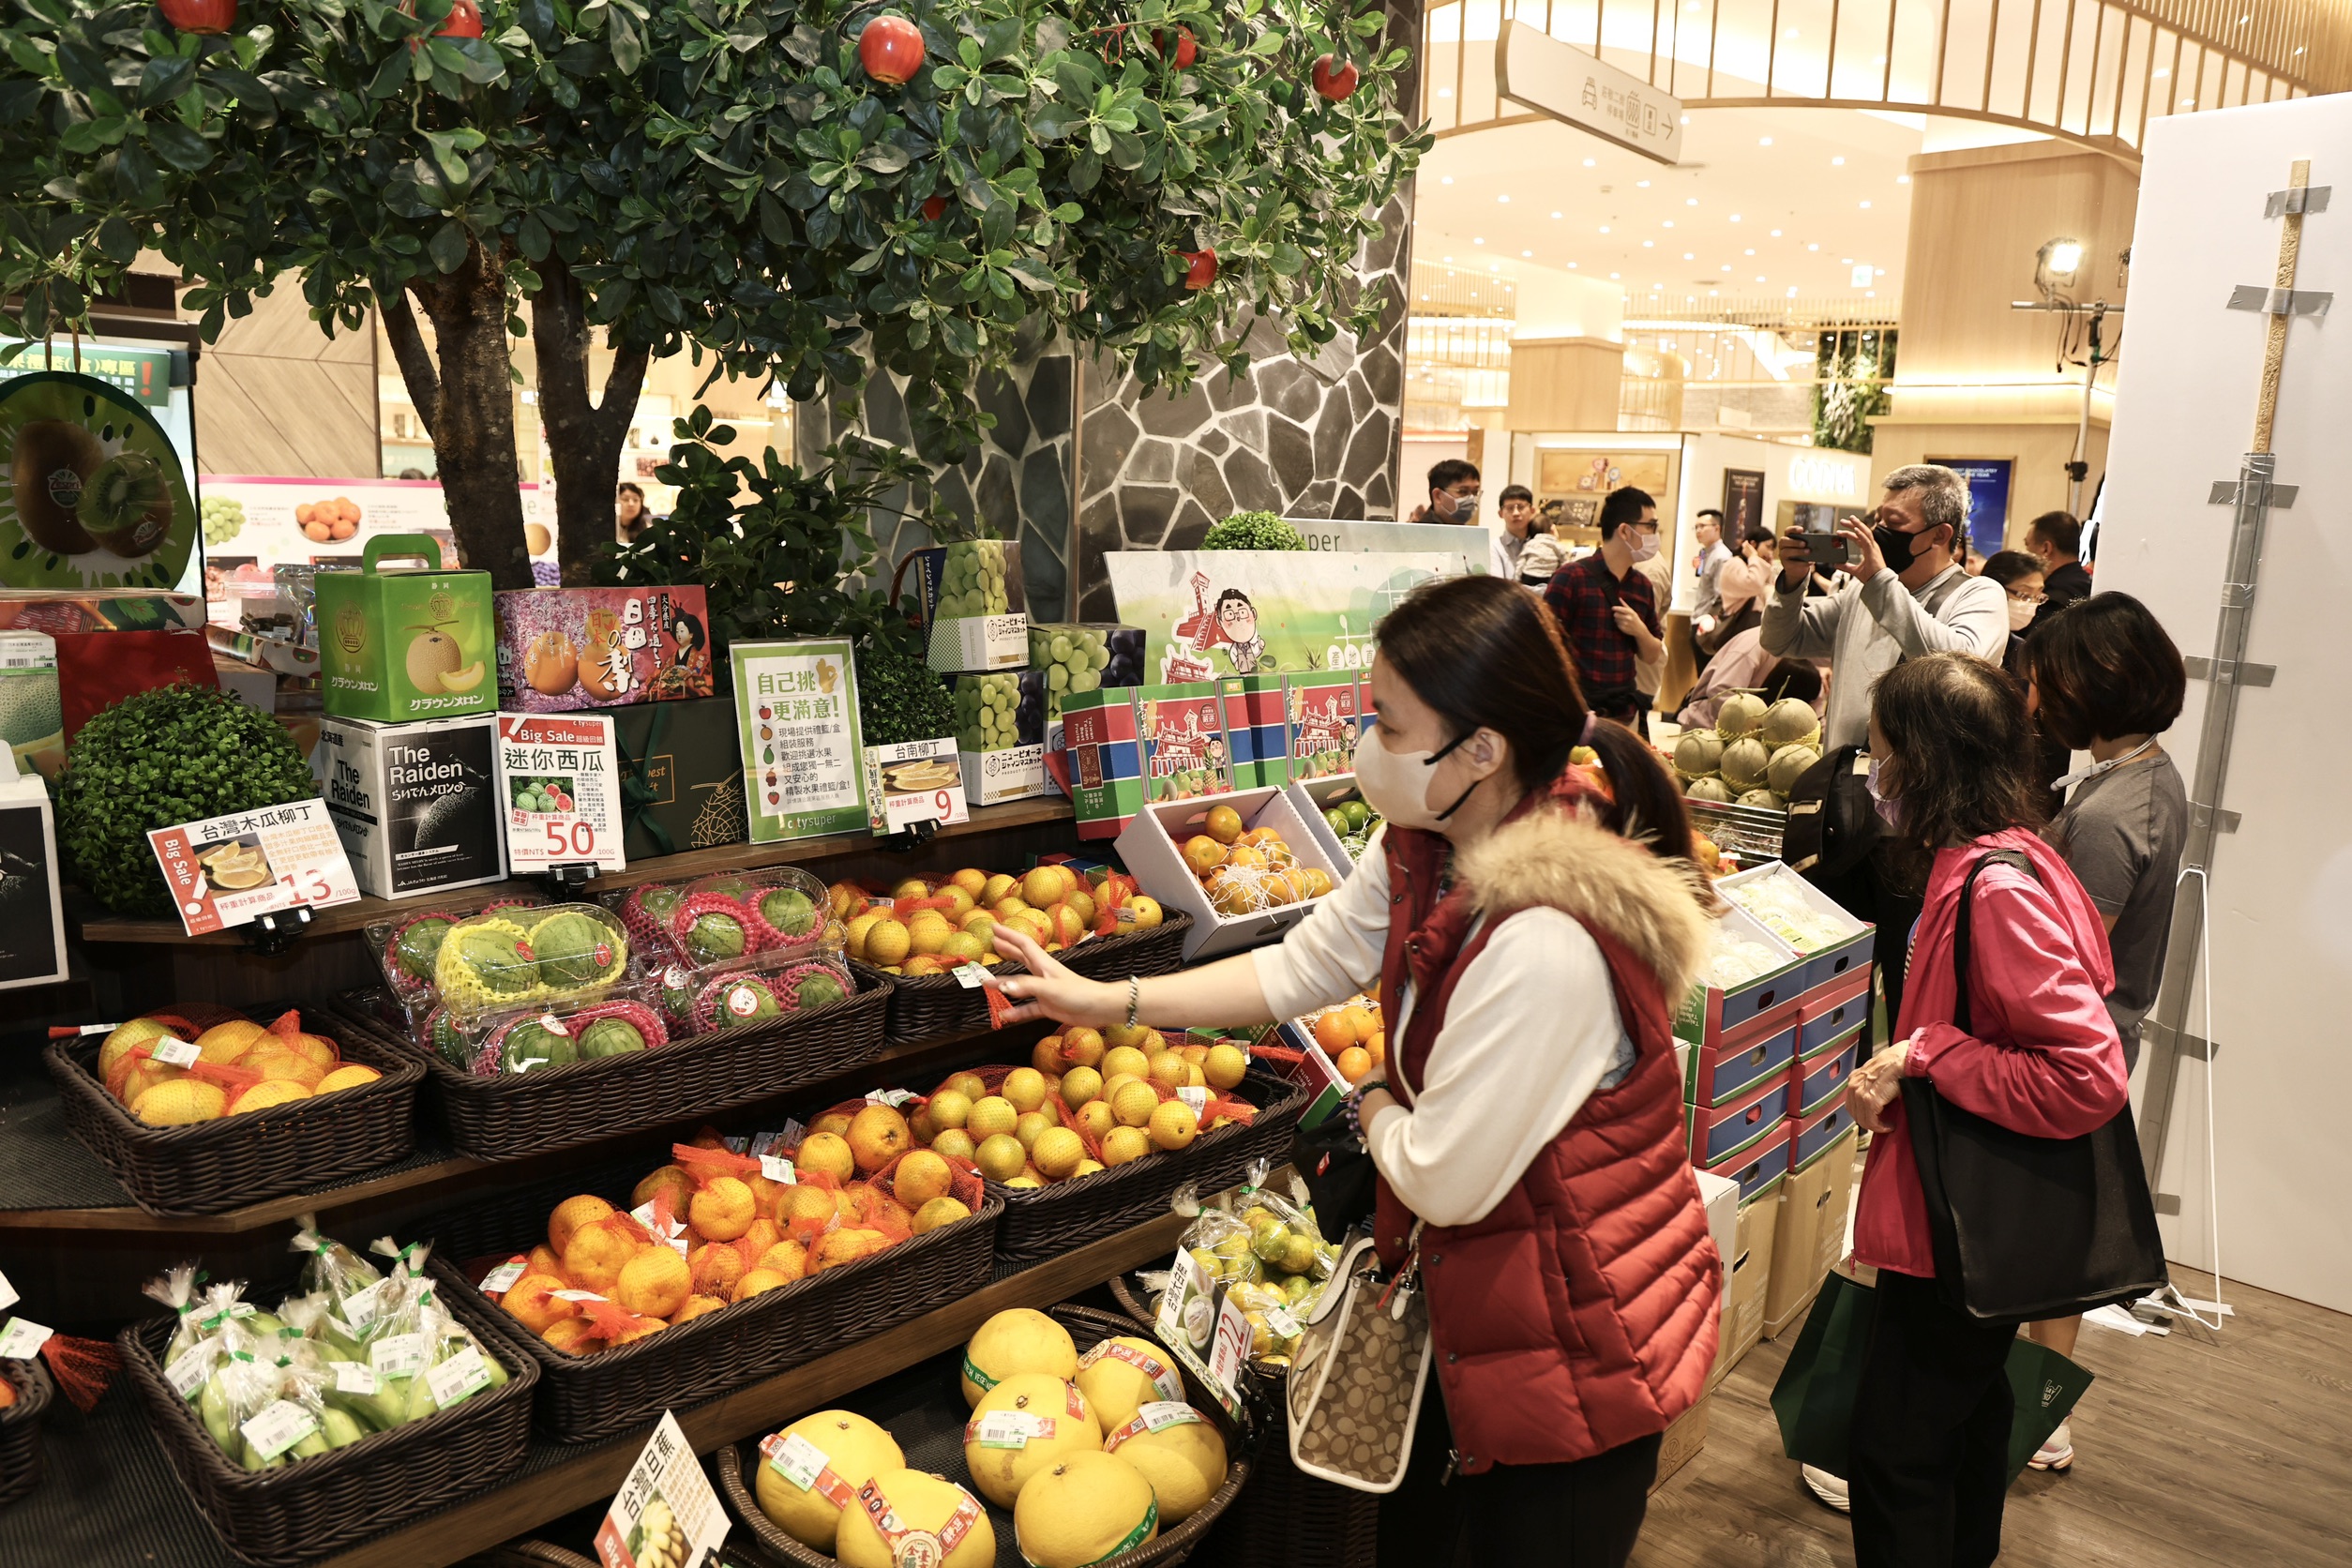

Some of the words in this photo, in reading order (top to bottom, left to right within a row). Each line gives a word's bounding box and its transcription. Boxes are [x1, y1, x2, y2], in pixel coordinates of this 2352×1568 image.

[51, 478, 80, 490] Zespri
[924, 555, 935, 610] シャインマスカット
[660, 596, 671, 629] 大分県産
[997, 617, 1026, 627] ニューピオーネ
[591, 612, 606, 647] 日本
[624, 598, 647, 649] 日田
[998, 626, 1027, 636] シャインマスカット
[331, 676, 379, 692] クラウンメロン
[758, 670, 816, 695] 自己挑
[410, 693, 485, 711] クラウンメロン
[772, 696, 839, 722] 更滿意!
[520, 730, 543, 744] Big
[547, 730, 575, 742] Sale
[778, 723, 841, 737] 現場提供禮籃/盒
[779, 737, 814, 749] 組裝服務
[896, 741, 940, 760] 台南柳丁
[389, 746, 430, 766] The
[505, 747, 605, 772] 迷你西瓜
[781, 747, 833, 761] 歡迎挑選水果
[1002, 747, 1042, 761] ニューピオーネ
[1002, 758, 1042, 769] シャインマスカット
[338, 760, 360, 785] The
[389, 762, 463, 786] Raiden
[782, 759, 842, 773] 組成您獨一無二
[784, 773, 819, 785] 又安心的
[785, 780, 851, 796] 精製水果禮籃/盒!
[331, 779, 370, 810] Raiden
[889, 796, 925, 808] 秤重計算商品
[935, 790, 952, 821] 9
[201, 805, 312, 841] 台灣木瓜柳丁
[547, 822, 595, 855] 50
[164, 838, 180, 860] Big
[173, 861, 192, 886] Sale
[280, 868, 332, 906] 13
[335, 888, 356, 898] /100g
[219, 893, 276, 912] 秤重計算商品
[1300, 1068, 1313, 1087] Fruits
[1165, 1261, 1188, 1313] 台灣大白柚
[1219, 1313, 1244, 1359] 22
[623, 1427, 676, 1522] 台灣旦蕉
